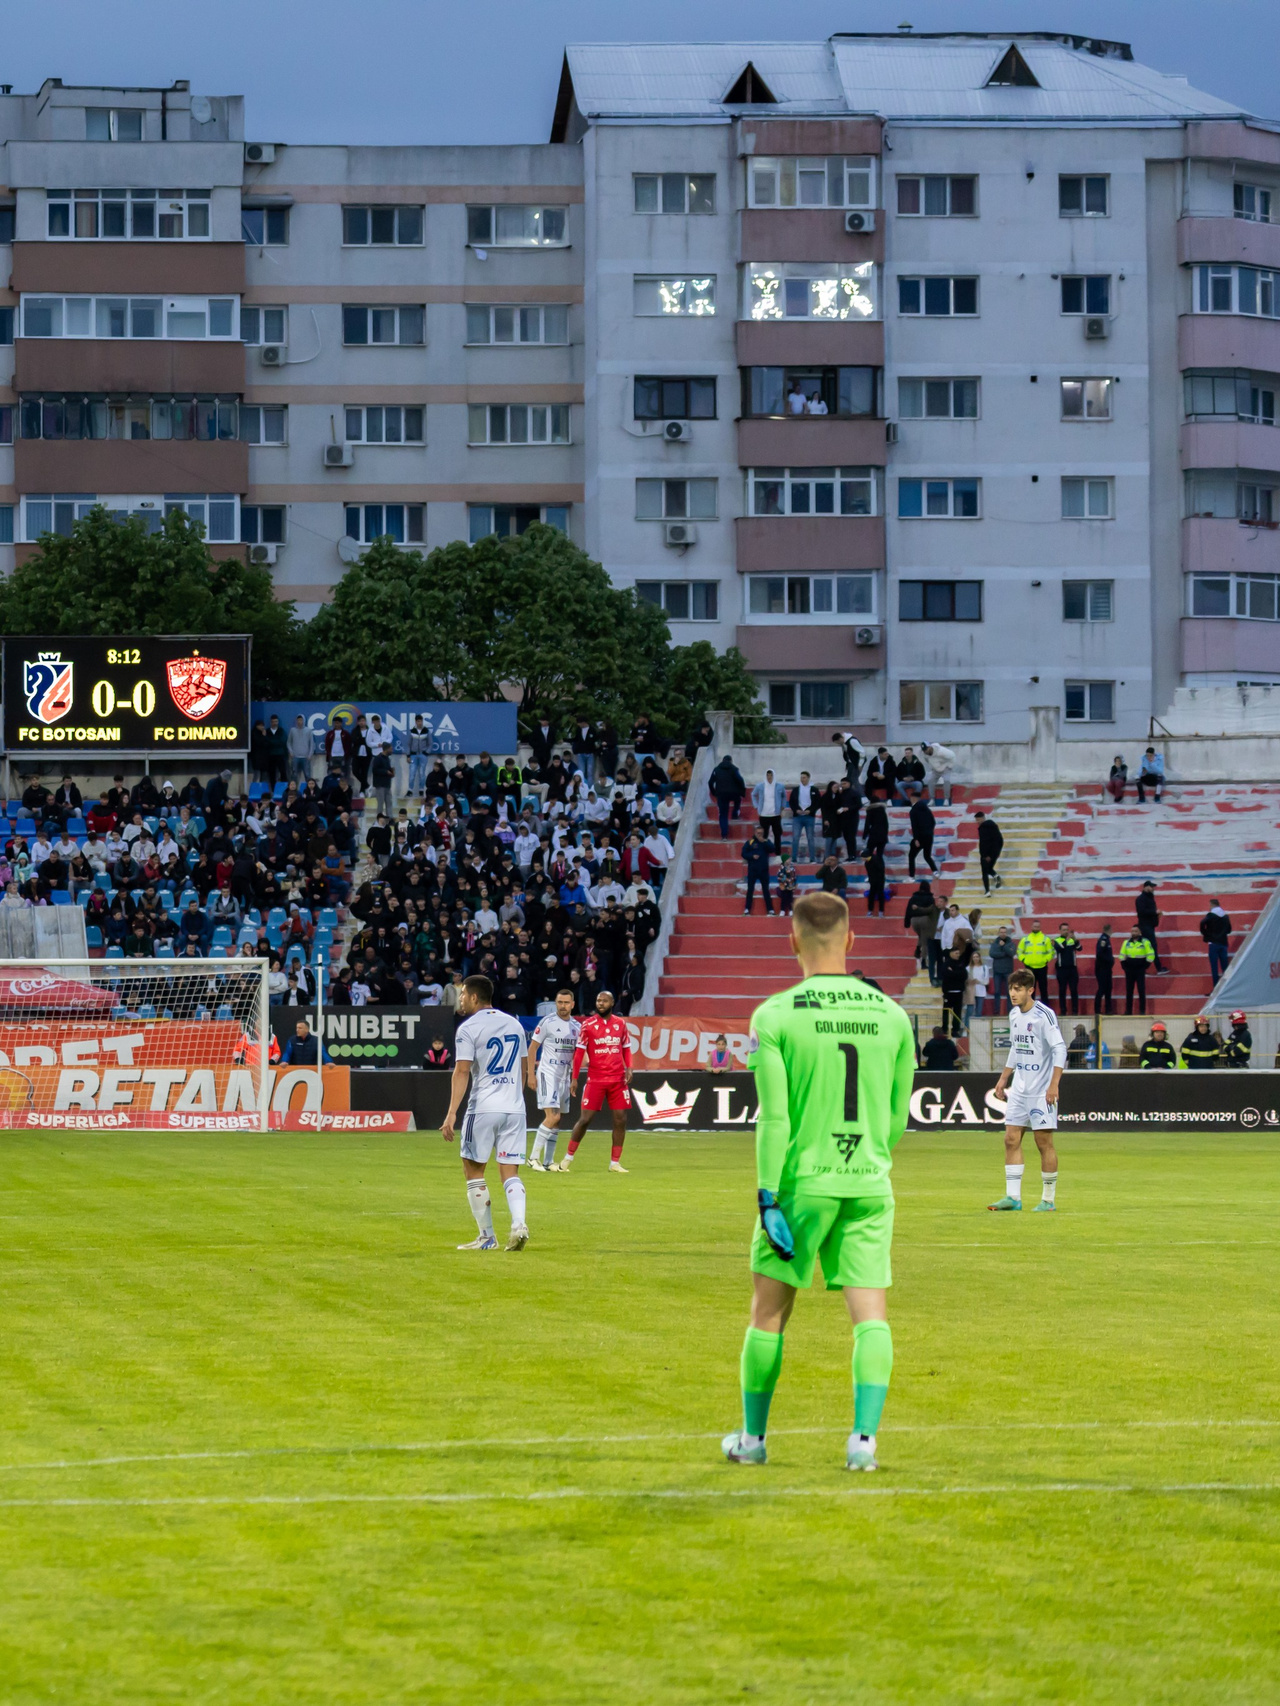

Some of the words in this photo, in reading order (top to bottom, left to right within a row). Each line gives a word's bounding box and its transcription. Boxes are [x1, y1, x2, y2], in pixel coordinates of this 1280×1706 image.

[107, 649, 141, 664] 8:12
[92, 680, 155, 717] 0-0
[19, 728, 39, 741] FC
[43, 728, 120, 741] BOTOSANI
[154, 727, 176, 740] FC
[178, 727, 237, 740] DINAMO
[806, 990, 884, 1004] Regata.ro
[305, 1014, 421, 1040] UNIBET
[815, 1020, 879, 1036] GOLUBOVIC
[486, 1034, 521, 1076] 27
[838, 1042, 859, 1123] 1
[26, 1111, 132, 1129] SUPERLIGA
[169, 1112, 260, 1129] SUPERBET
[298, 1112, 395, 1129] SUPERLIGA
[1088, 1111, 1123, 1122] ONJN:
[1125, 1111, 1141, 1122] Nr.
[1142, 1111, 1237, 1122] L1213853W001291
[836, 1165, 880, 1176] GAMING
